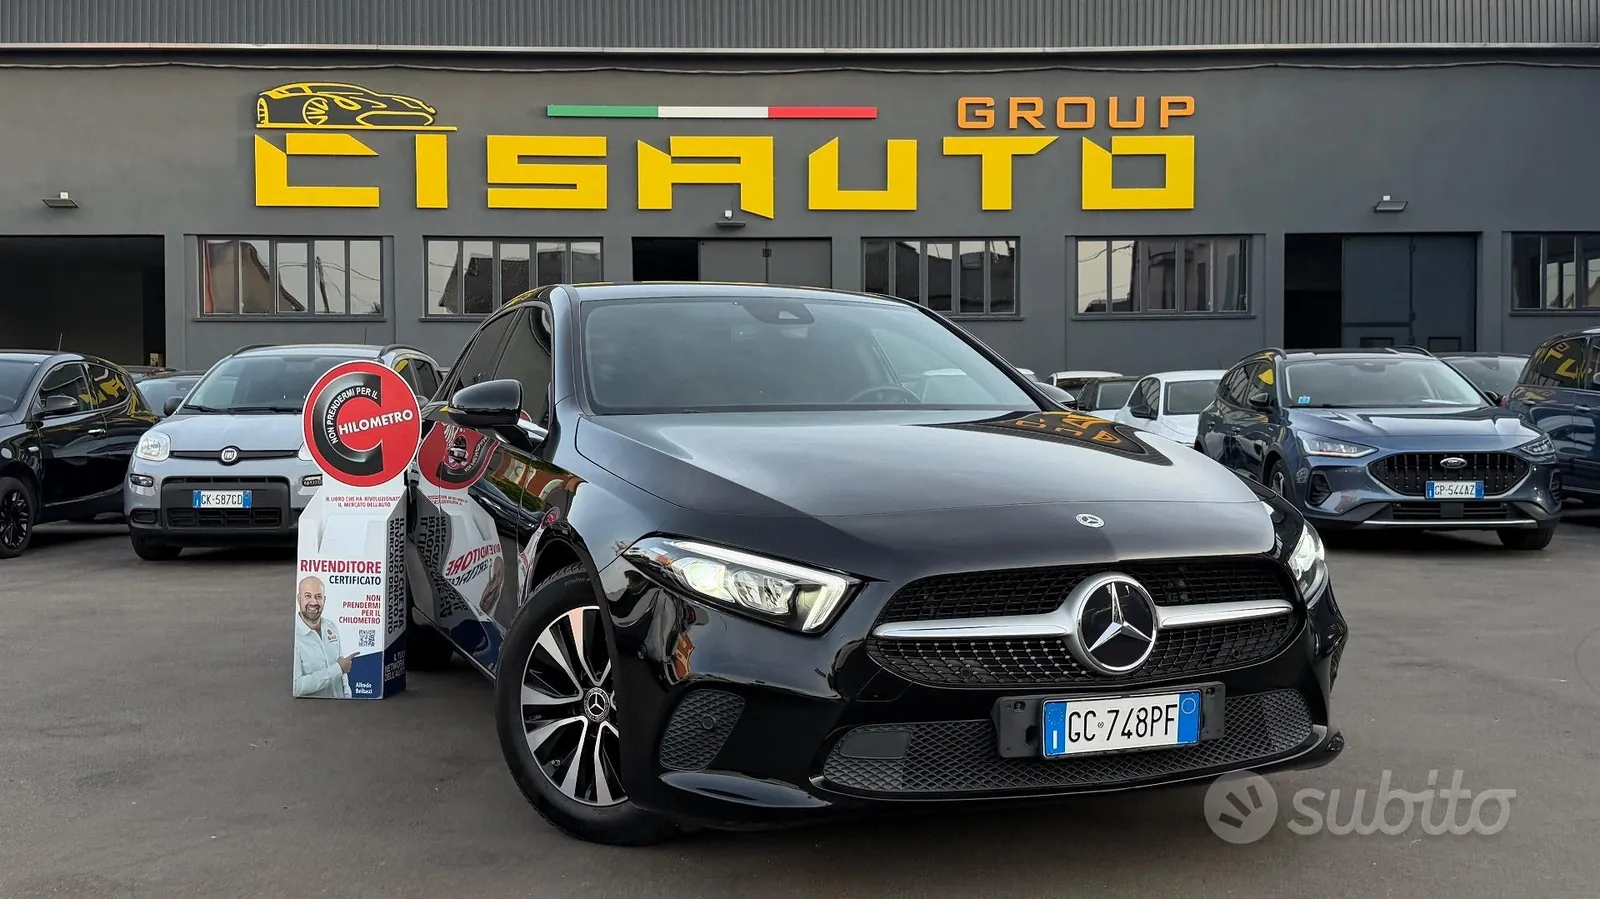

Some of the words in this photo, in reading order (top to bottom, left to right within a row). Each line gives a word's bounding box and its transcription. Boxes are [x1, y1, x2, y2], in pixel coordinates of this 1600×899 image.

[957, 96, 1195, 129] GROUP
[255, 134, 1195, 219] CISAUTO
[356, 387, 372, 397] PER
[372, 390, 378, 400] IL
[327, 388, 355, 426] PRENDERMI
[328, 427, 339, 445] NON
[399, 517, 405, 530] IL
[300, 559, 382, 574] RIVENDITORE
[329, 575, 382, 586] CERTIFICATO
[366, 594, 381, 602] NON
[343, 601, 381, 609] PRENDERMI
[338, 616, 381, 625] CHILOMETRO
[398, 609, 404, 629] HA
[393, 620, 399, 632] IL
[1068, 710, 1097, 743] GC
[1106, 704, 1178, 741] 748PF
